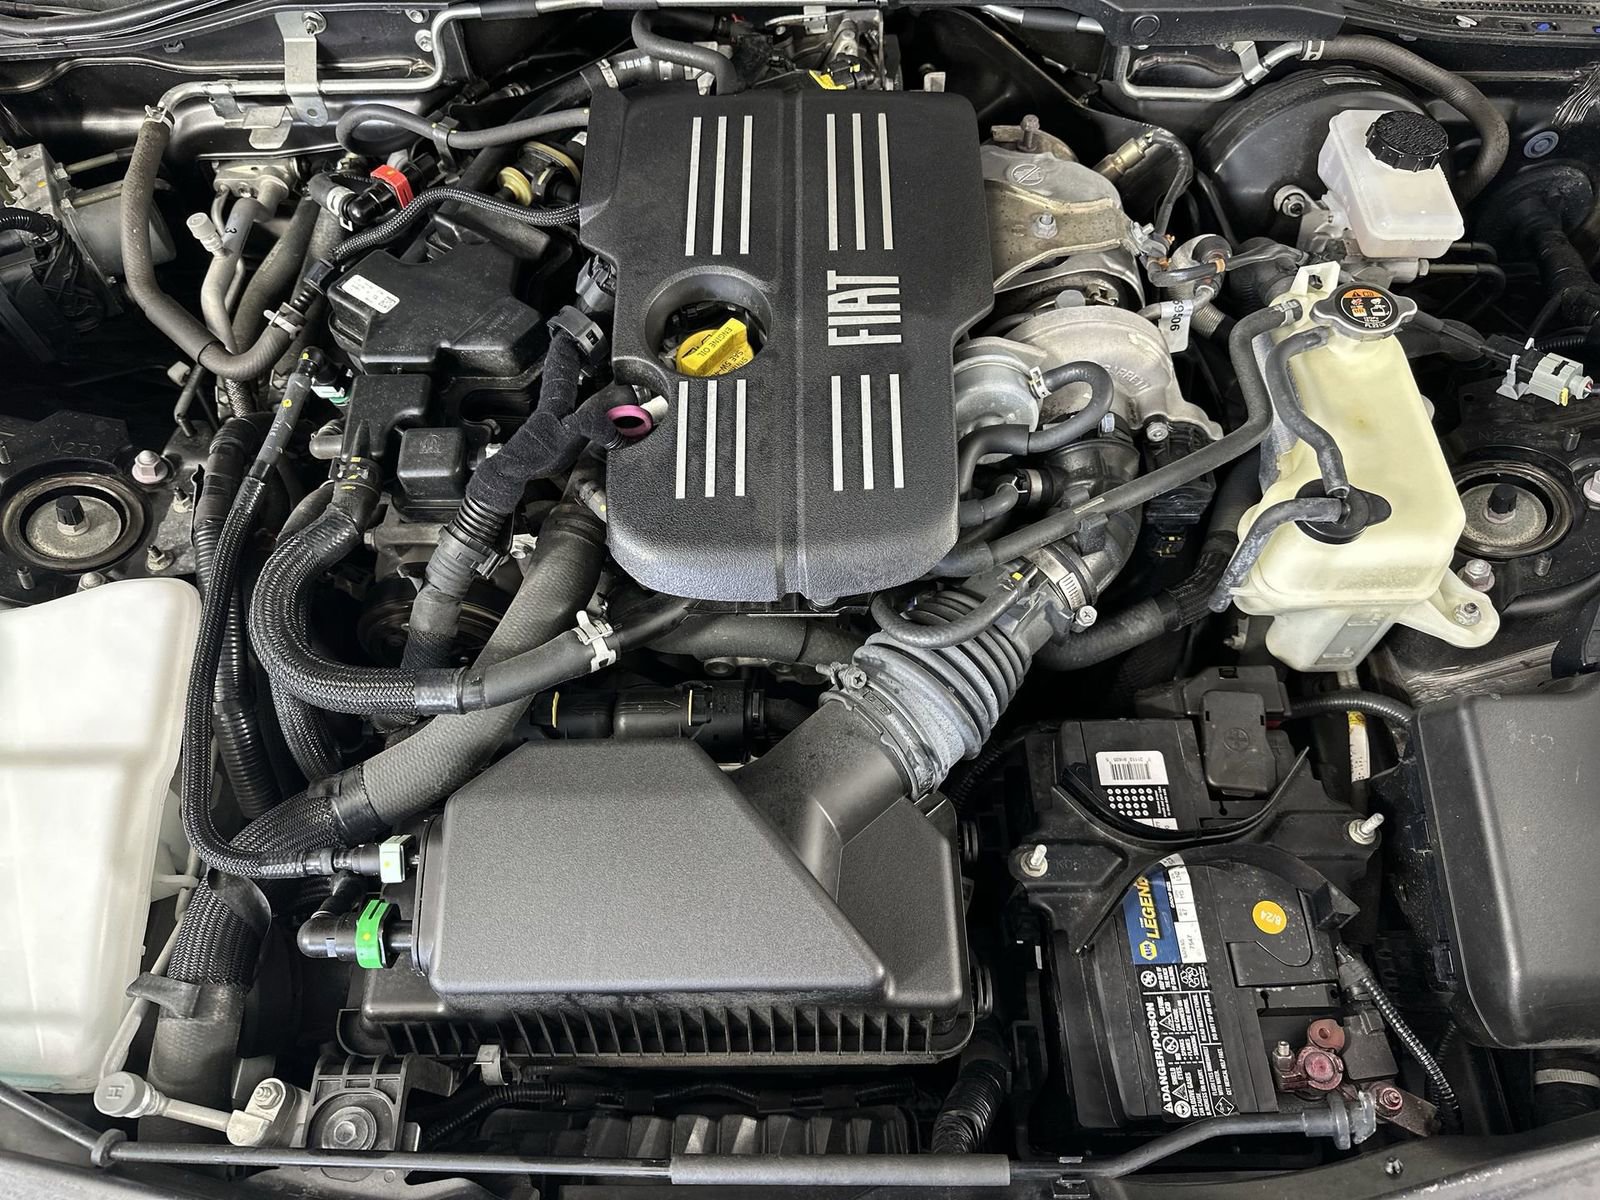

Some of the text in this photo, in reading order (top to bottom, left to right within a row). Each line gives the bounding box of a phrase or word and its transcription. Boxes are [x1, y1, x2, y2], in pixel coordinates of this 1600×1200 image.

[827, 270, 901, 346] FIAT
[697, 326, 732, 356] ENGINE OIL
[729, 350, 744, 362] SAE
[1133, 876, 1160, 939] LEGEND
[1143, 944, 1152, 957] NAPA
[1178, 1007, 1188, 1031] BLINDNESS
[1186, 1014, 1194, 1030] SEVERE
[1145, 1002, 1172, 1102] DANGER/POISON
[1179, 1038, 1187, 1056] SPARKS
[1185, 1038, 1193, 1056] FLAMES
[1190, 1036, 1200, 1056] SMOKING
[1170, 1068, 1178, 1086] SHIELD
[1176, 1066, 1184, 1080] EYES.
[1222, 1070, 1230, 1088] MEDICAL
[1184, 1072, 1199, 1116] EXPLOSIVE GASES
[1210, 1082, 1218, 1096] FLUSH
[1202, 1092, 1212, 1115] BLINDNESS
